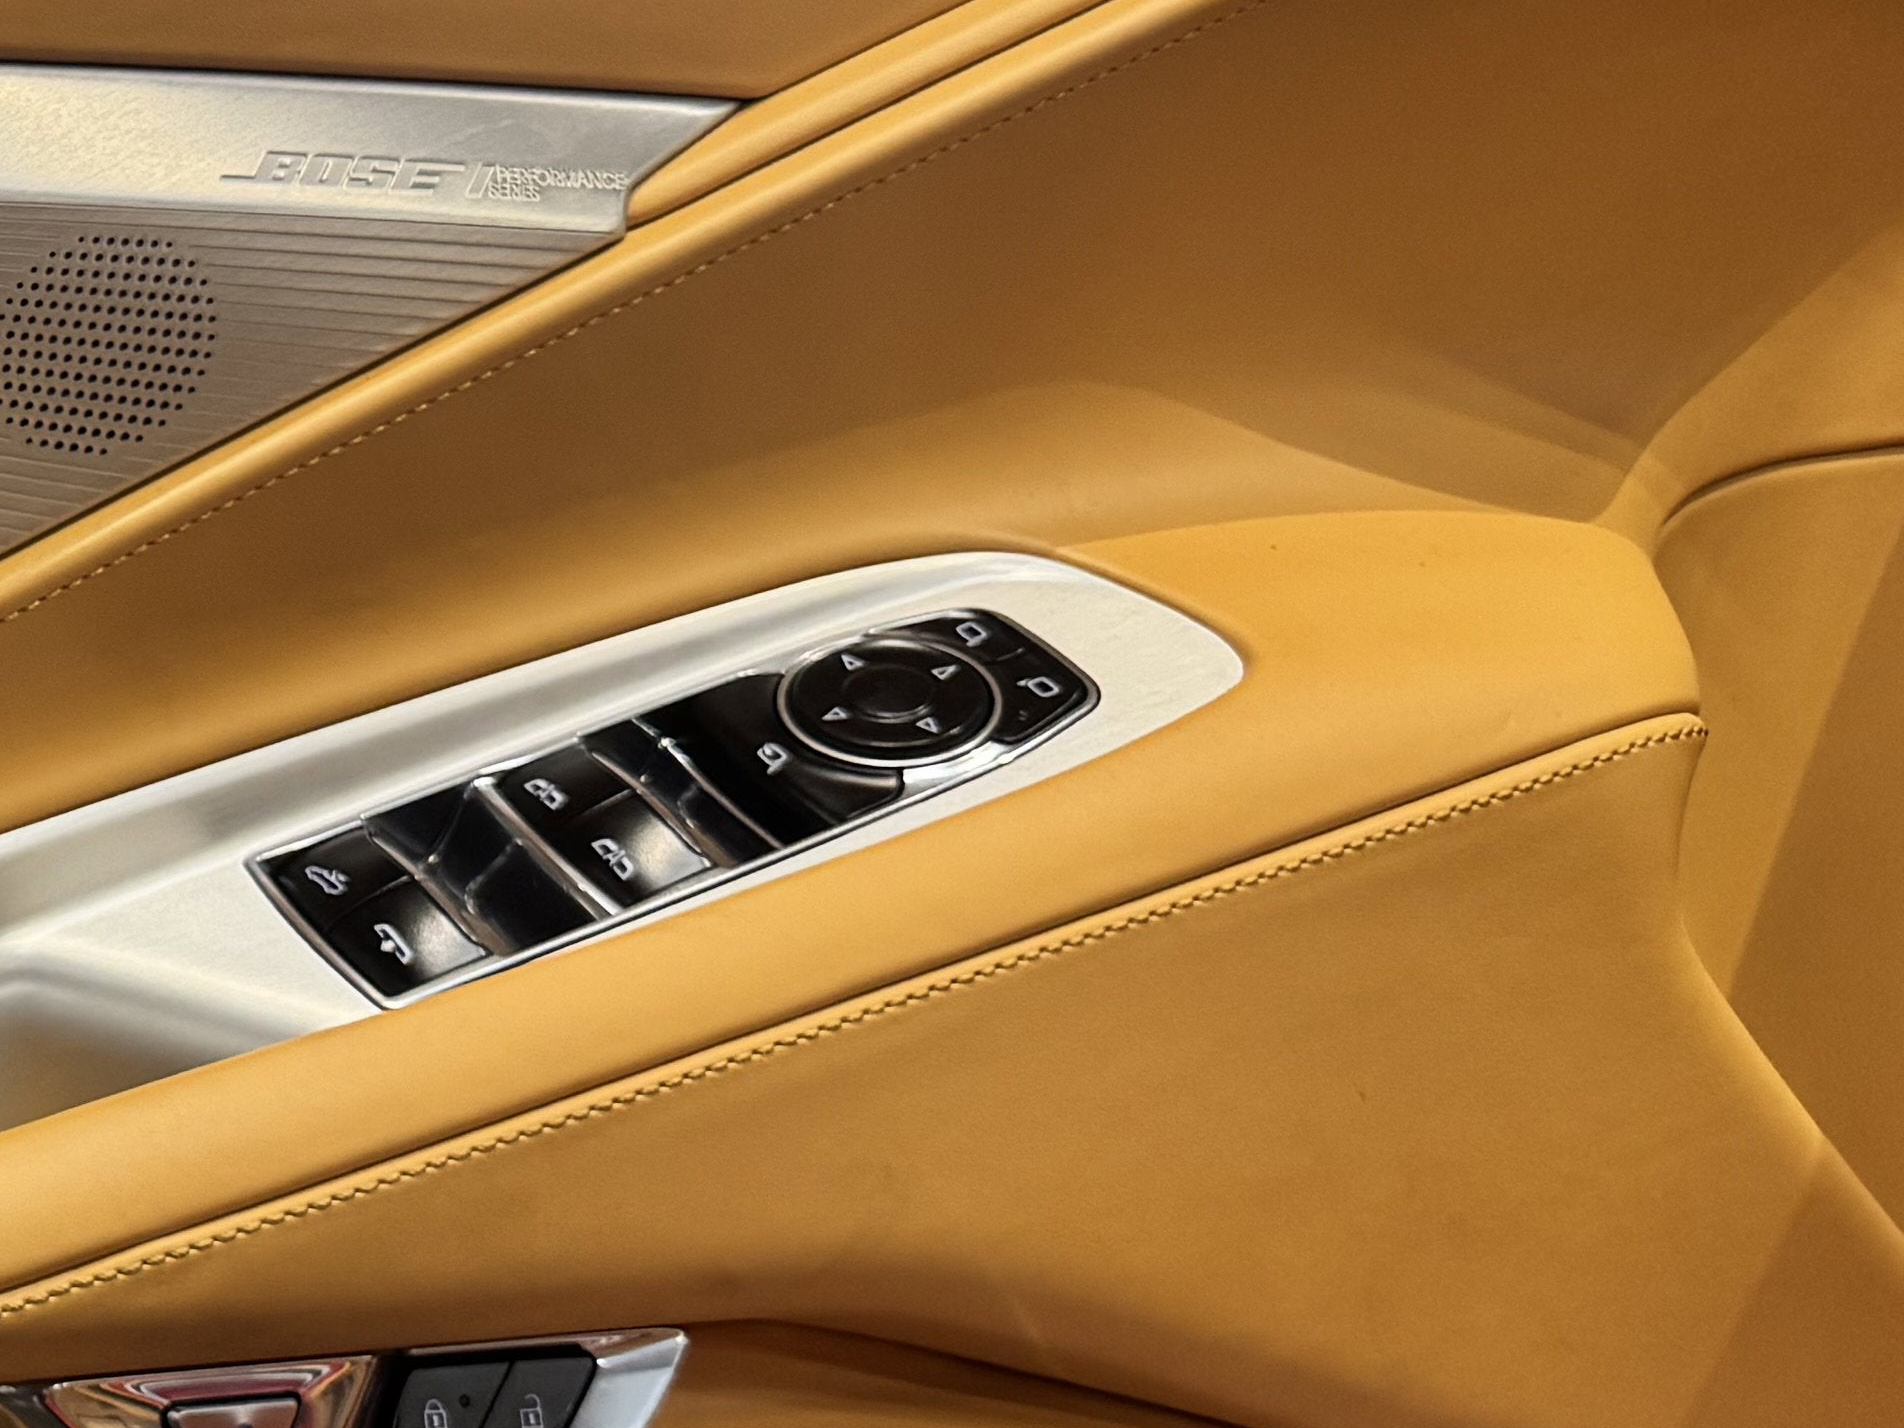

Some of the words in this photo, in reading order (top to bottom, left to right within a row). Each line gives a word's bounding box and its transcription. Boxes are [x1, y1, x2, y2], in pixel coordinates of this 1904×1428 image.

[220, 150, 466, 196] BOSE
[495, 165, 628, 191] PERFORMANCE
[488, 181, 541, 202] SERIES
